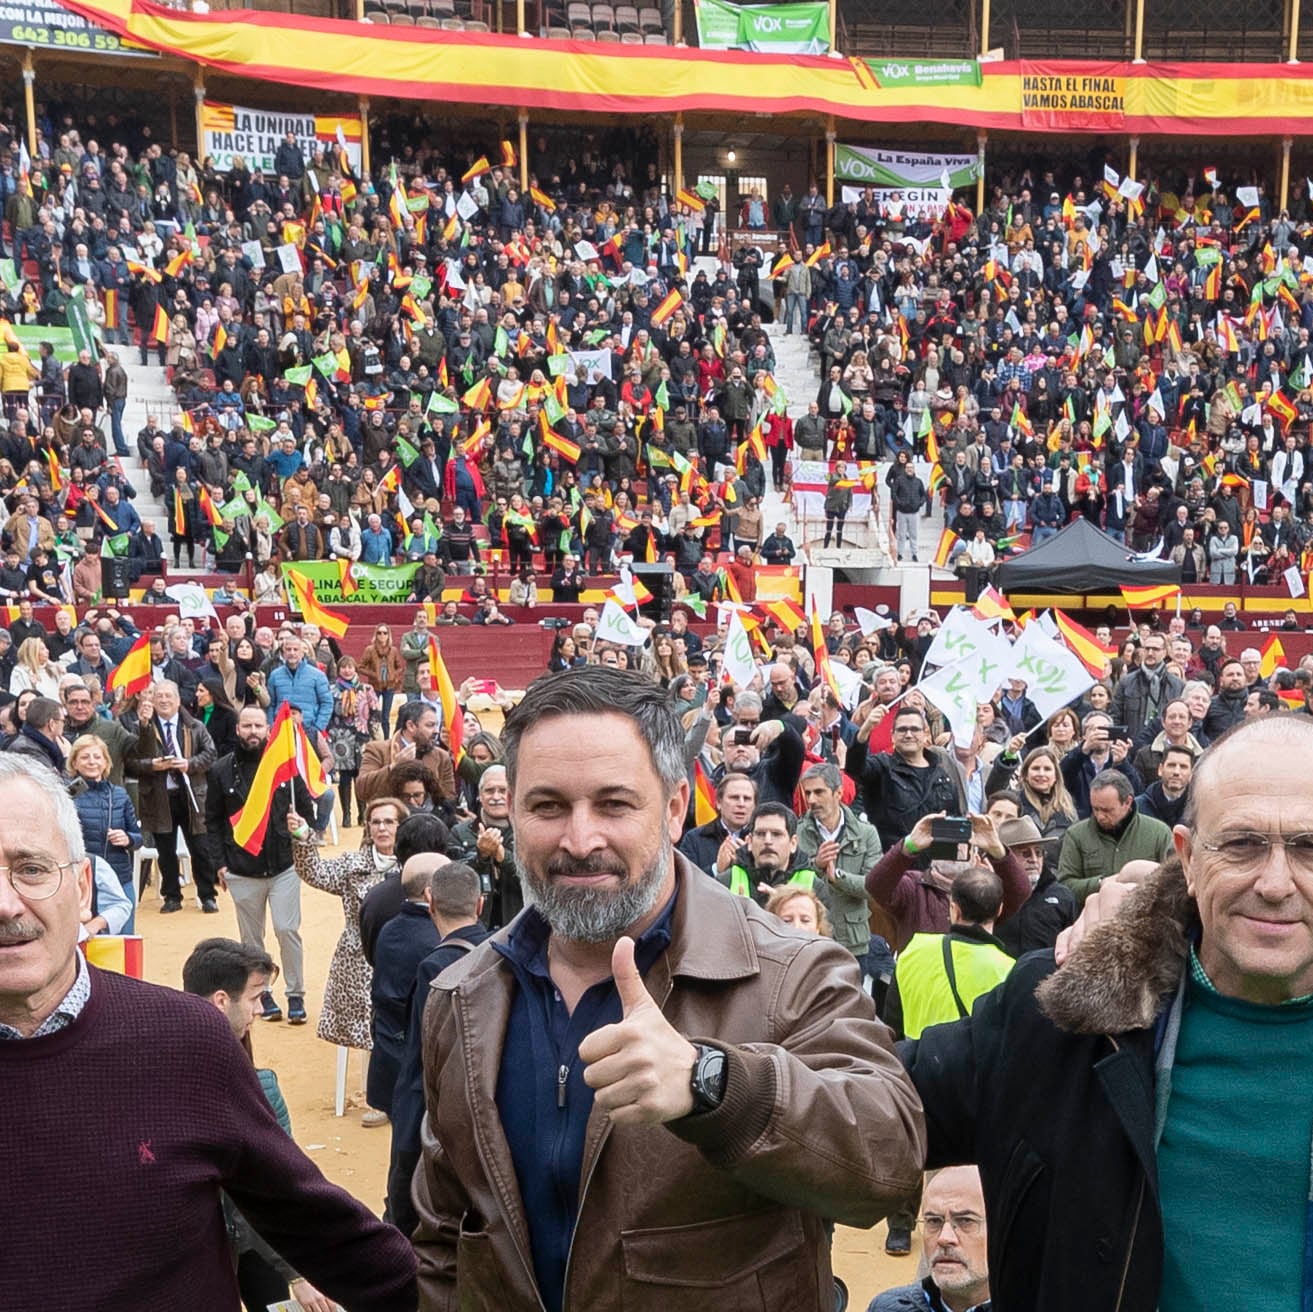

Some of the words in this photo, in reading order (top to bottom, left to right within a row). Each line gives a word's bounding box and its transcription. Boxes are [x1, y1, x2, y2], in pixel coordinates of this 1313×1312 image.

[27, 9, 43, 23] LA
[45, 11, 85, 28] MEJOR
[753, 16, 782, 32] VOX
[12, 26, 49, 43] 642
[54, 29, 90, 47] 306
[882, 63, 909, 79] VOX
[1023, 77, 1062, 91] HASTA
[1066, 78, 1078, 91] EL
[1082, 78, 1116, 92] FINAL
[1023, 94, 1067, 108] VAMOS
[1070, 95, 1125, 110] ABASCAL
[234, 113, 252, 132] LA
[255, 115, 316, 137] UNIDAD
[212, 131, 255, 153] HACE
[259, 136, 276, 154] LA
[877, 152, 893, 162] La
[896, 155, 942, 167] España
[944, 157, 971, 166] Viva
[840, 158, 876, 178] VOX
[288, 579, 343, 590] MLINA
[369, 580, 414, 590] SEGUR
